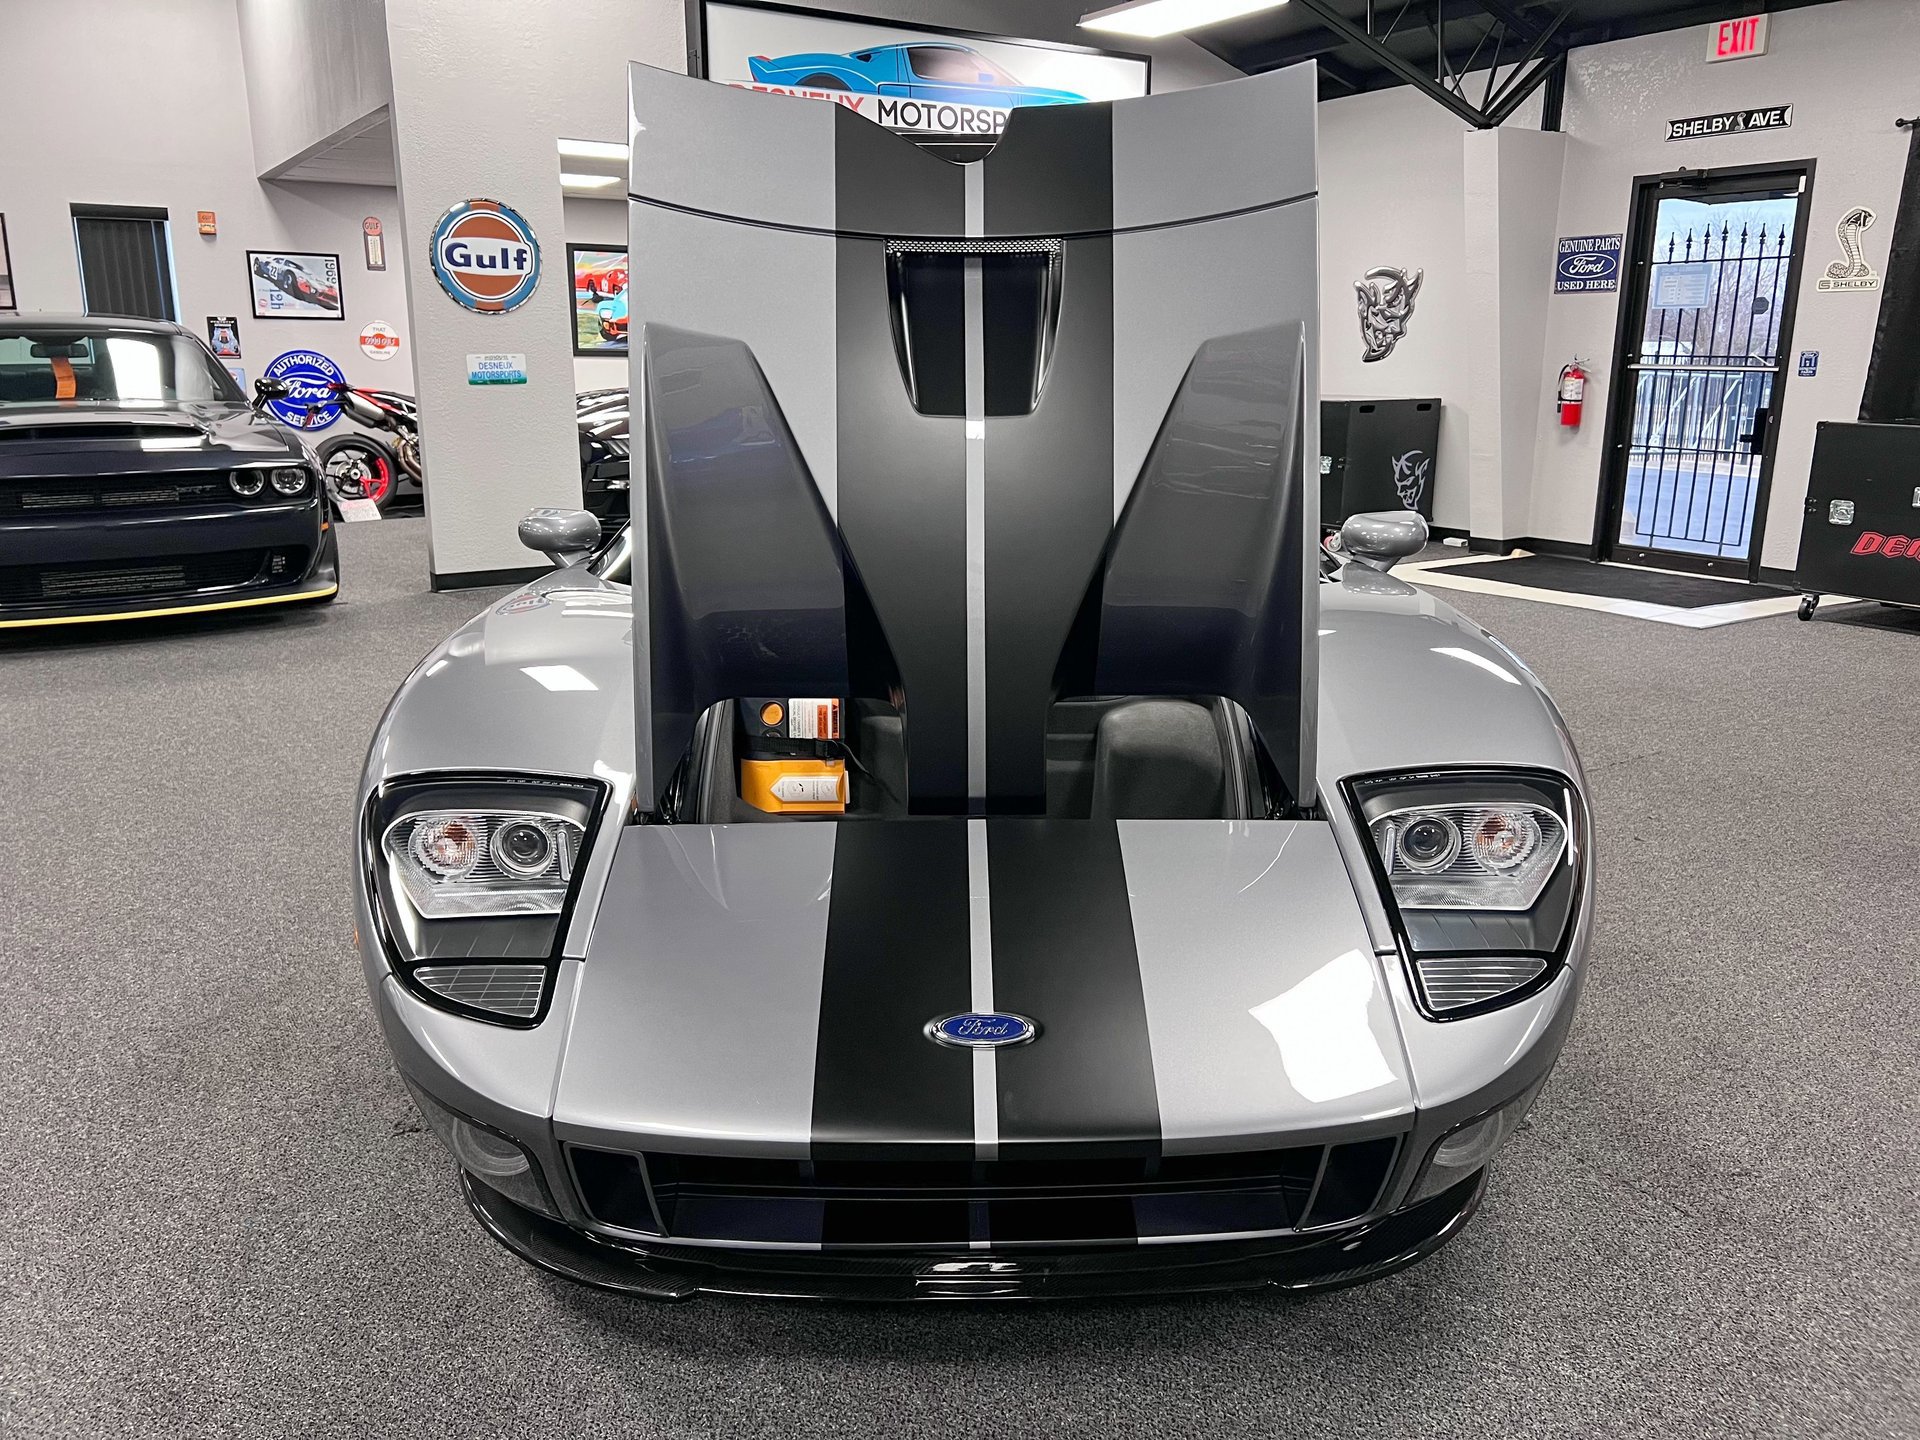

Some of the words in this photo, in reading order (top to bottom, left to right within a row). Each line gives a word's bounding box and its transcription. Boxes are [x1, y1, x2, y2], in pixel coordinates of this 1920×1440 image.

[1717, 17, 1760, 56] EXIT
[1672, 115, 1734, 138] SHELBY
[1748, 110, 1784, 128] AVE.
[1559, 239, 1594, 253] GENUINE
[1594, 237, 1621, 251] PARTS
[444, 242, 528, 271] Gulf
[1569, 256, 1606, 274] Ford
[1557, 280, 1585, 291] USED
[1585, 279, 1617, 290] HERE
[273, 355, 335, 376] AUTHORIZED
[471, 370, 522, 379] MOTORSPORTS
[478, 361, 513, 370] DESNEUX
[958, 1018, 1008, 1036] Ford
